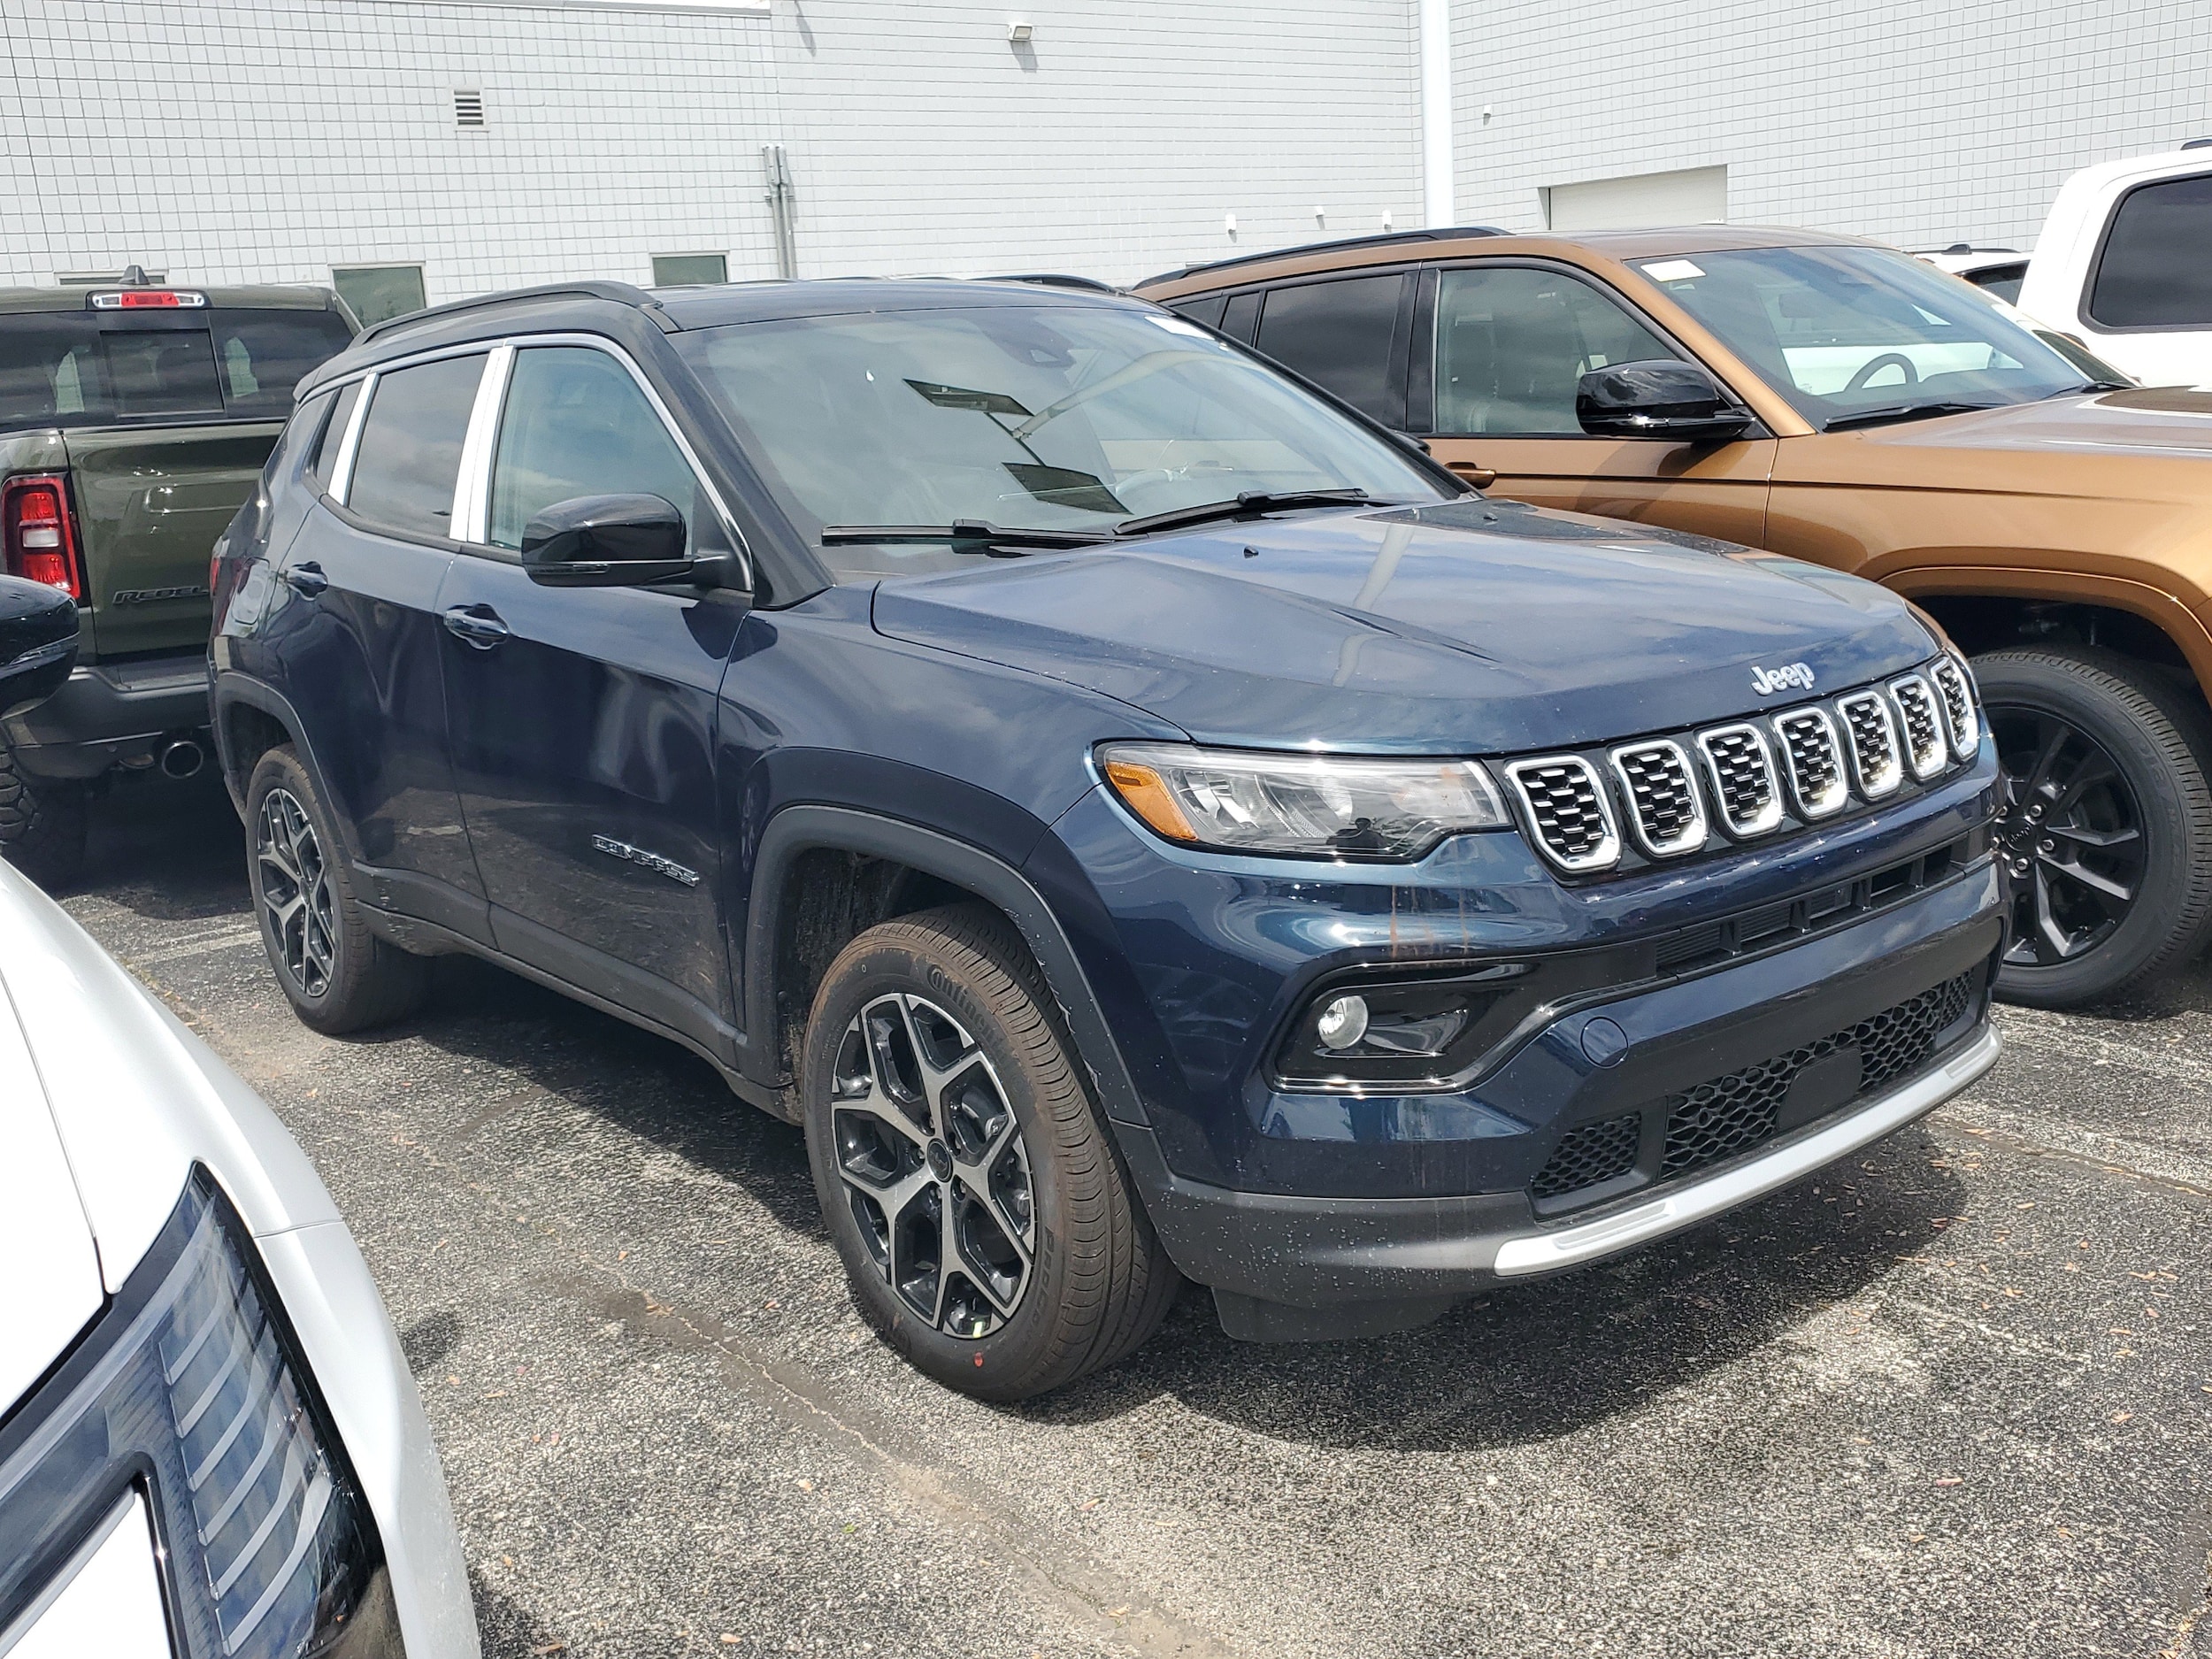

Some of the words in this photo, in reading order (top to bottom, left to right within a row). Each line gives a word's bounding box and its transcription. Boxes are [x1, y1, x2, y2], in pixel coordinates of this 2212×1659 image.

[111, 586, 211, 604] REBEL
[1749, 662, 1815, 695] Jeep
[927, 964, 1004, 1050] Continent
